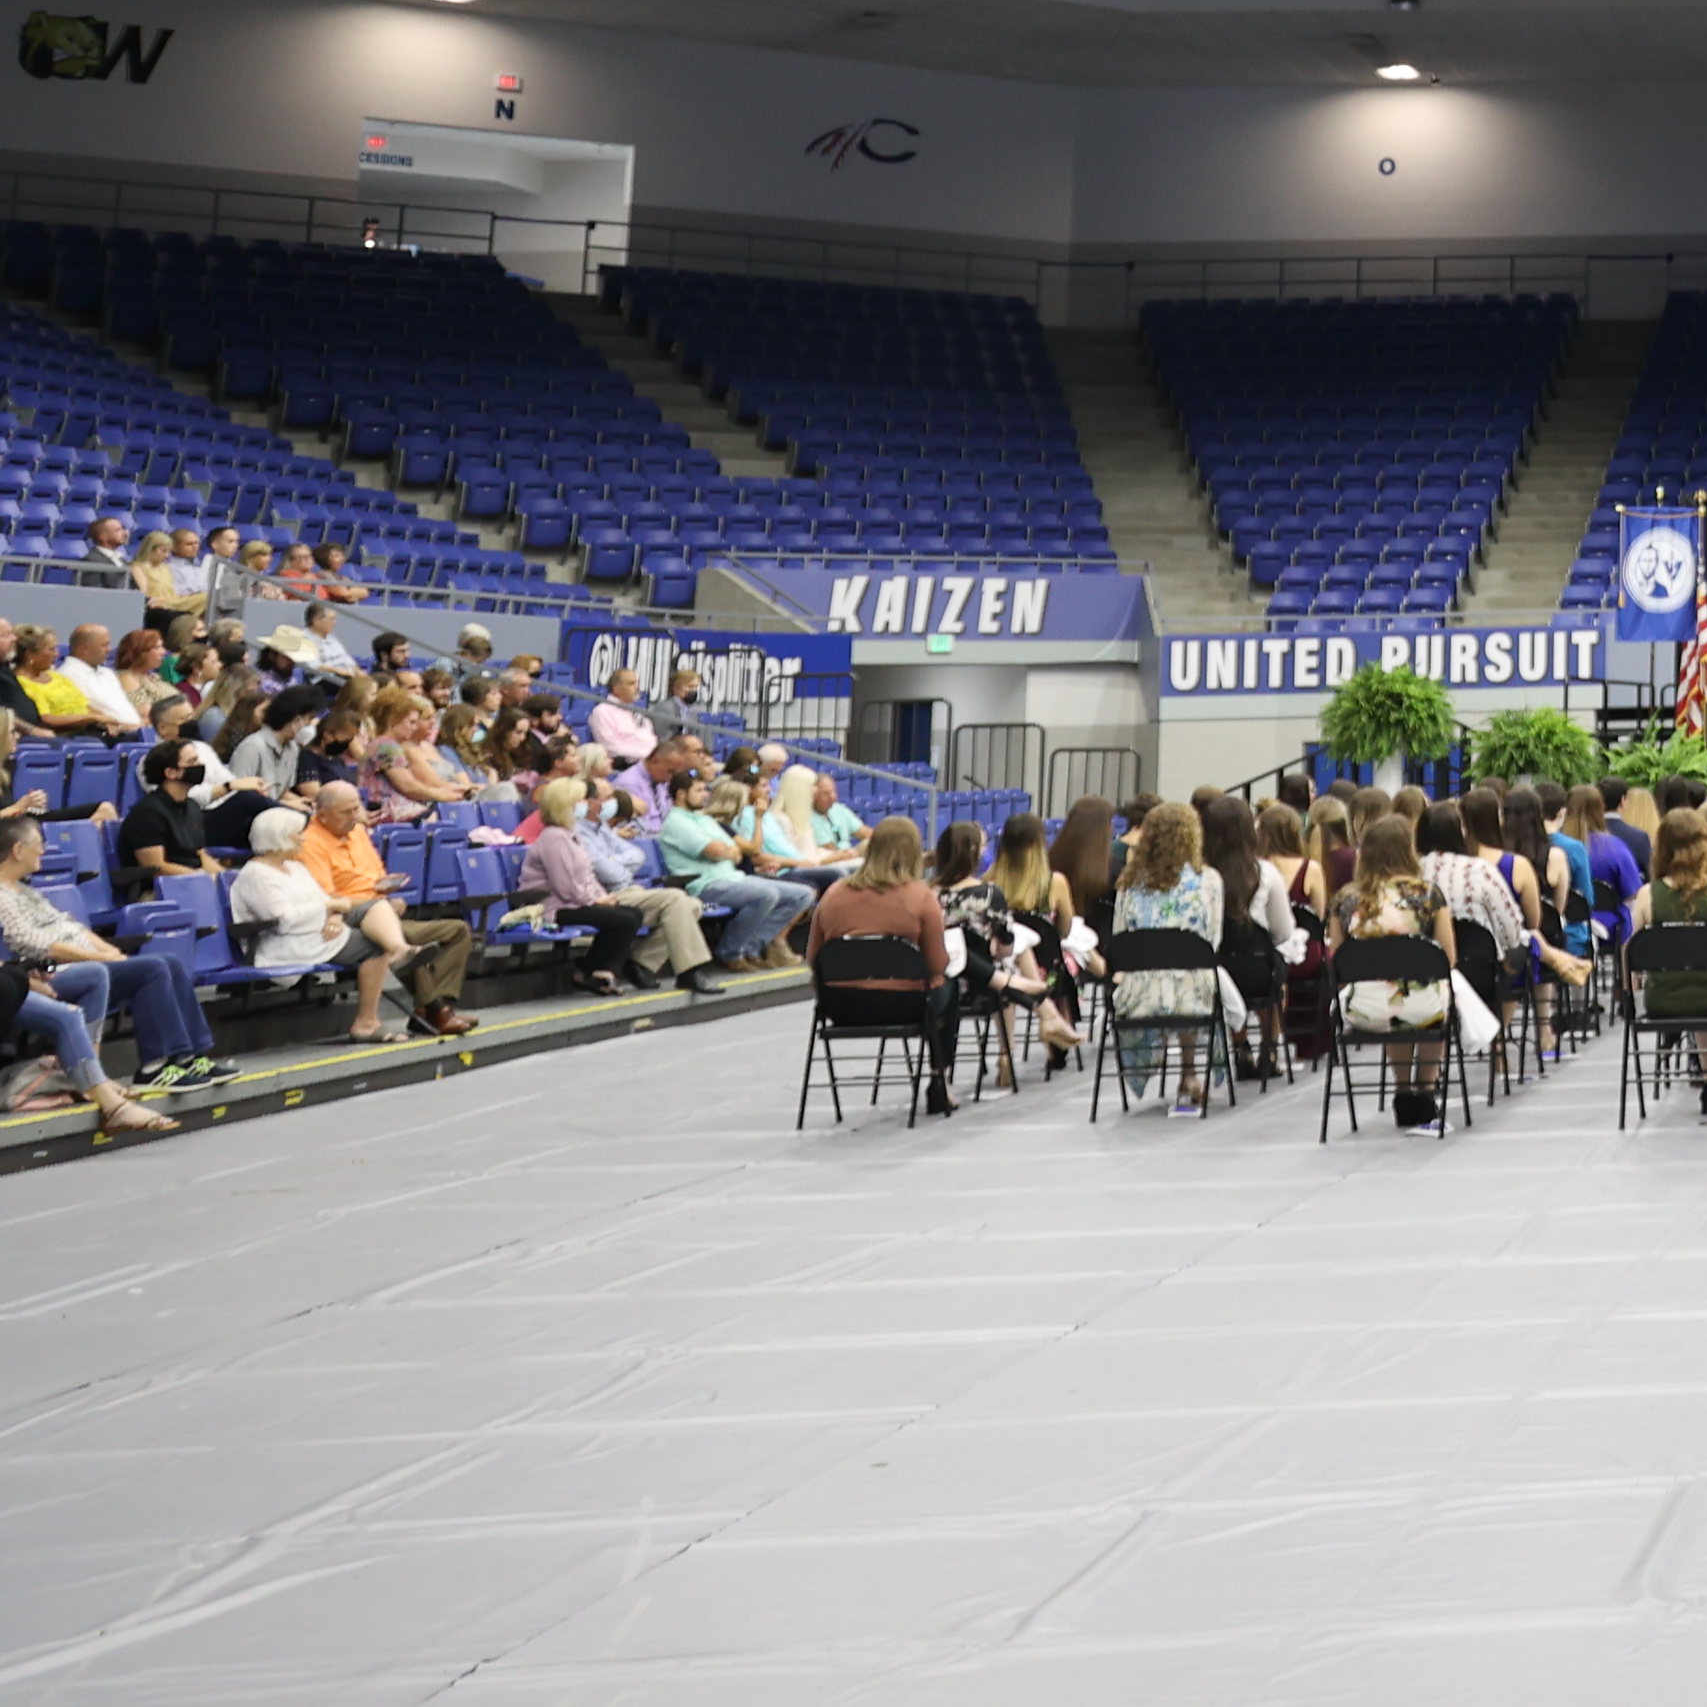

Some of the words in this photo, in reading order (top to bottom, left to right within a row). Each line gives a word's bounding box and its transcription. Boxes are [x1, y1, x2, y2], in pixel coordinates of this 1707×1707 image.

[494, 98, 516, 121] N
[827, 575, 1050, 635] KAIZEN
[1169, 635, 1355, 692] UNITED
[1381, 629, 1600, 686] PURSUIT
